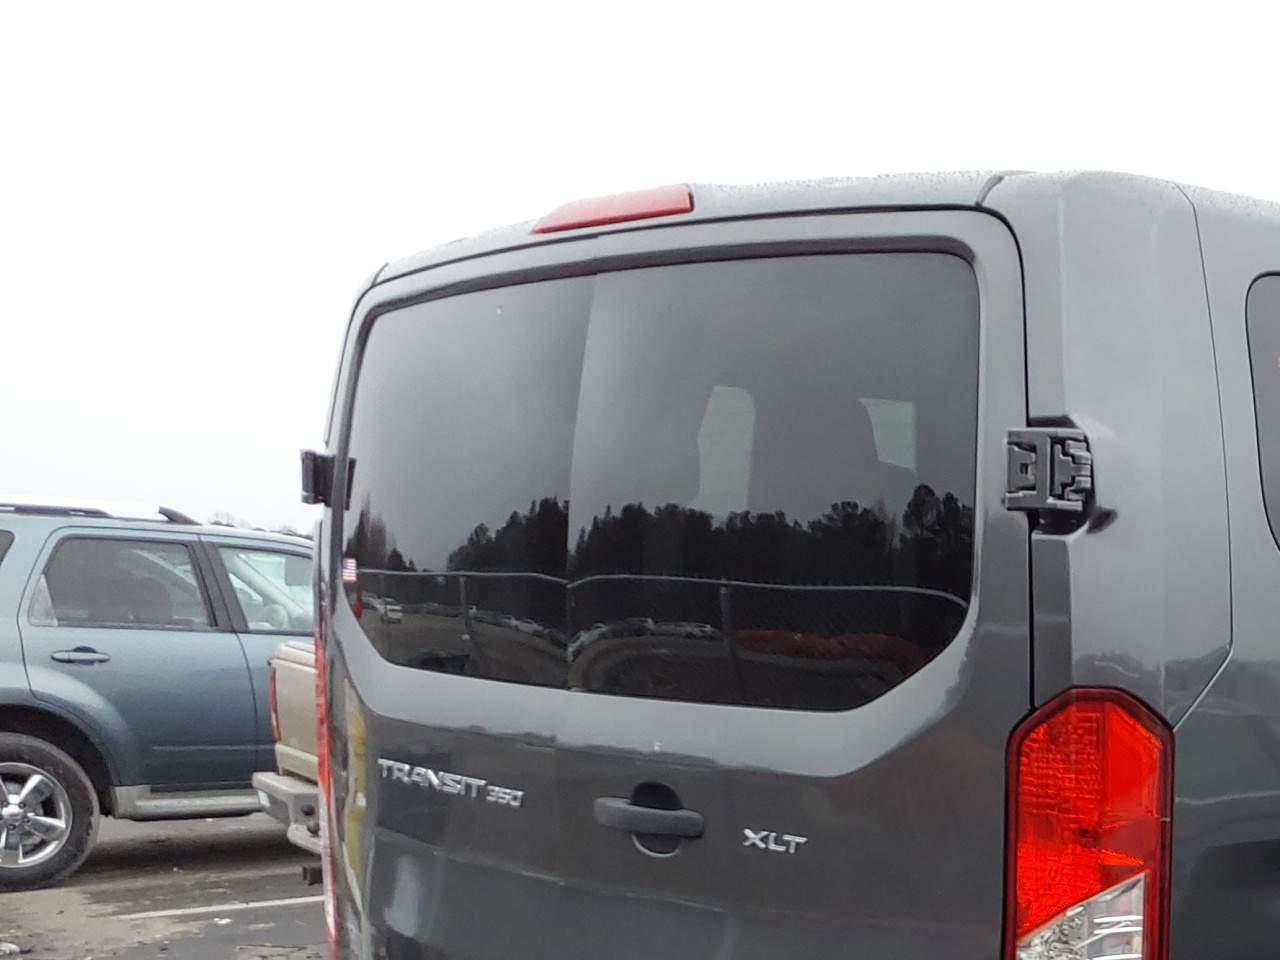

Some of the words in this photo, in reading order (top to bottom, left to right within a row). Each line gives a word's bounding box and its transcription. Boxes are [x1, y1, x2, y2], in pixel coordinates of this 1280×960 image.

[377, 757, 488, 798] TRANSIT
[486, 785, 526, 807] 350
[743, 828, 808, 854] XLT
